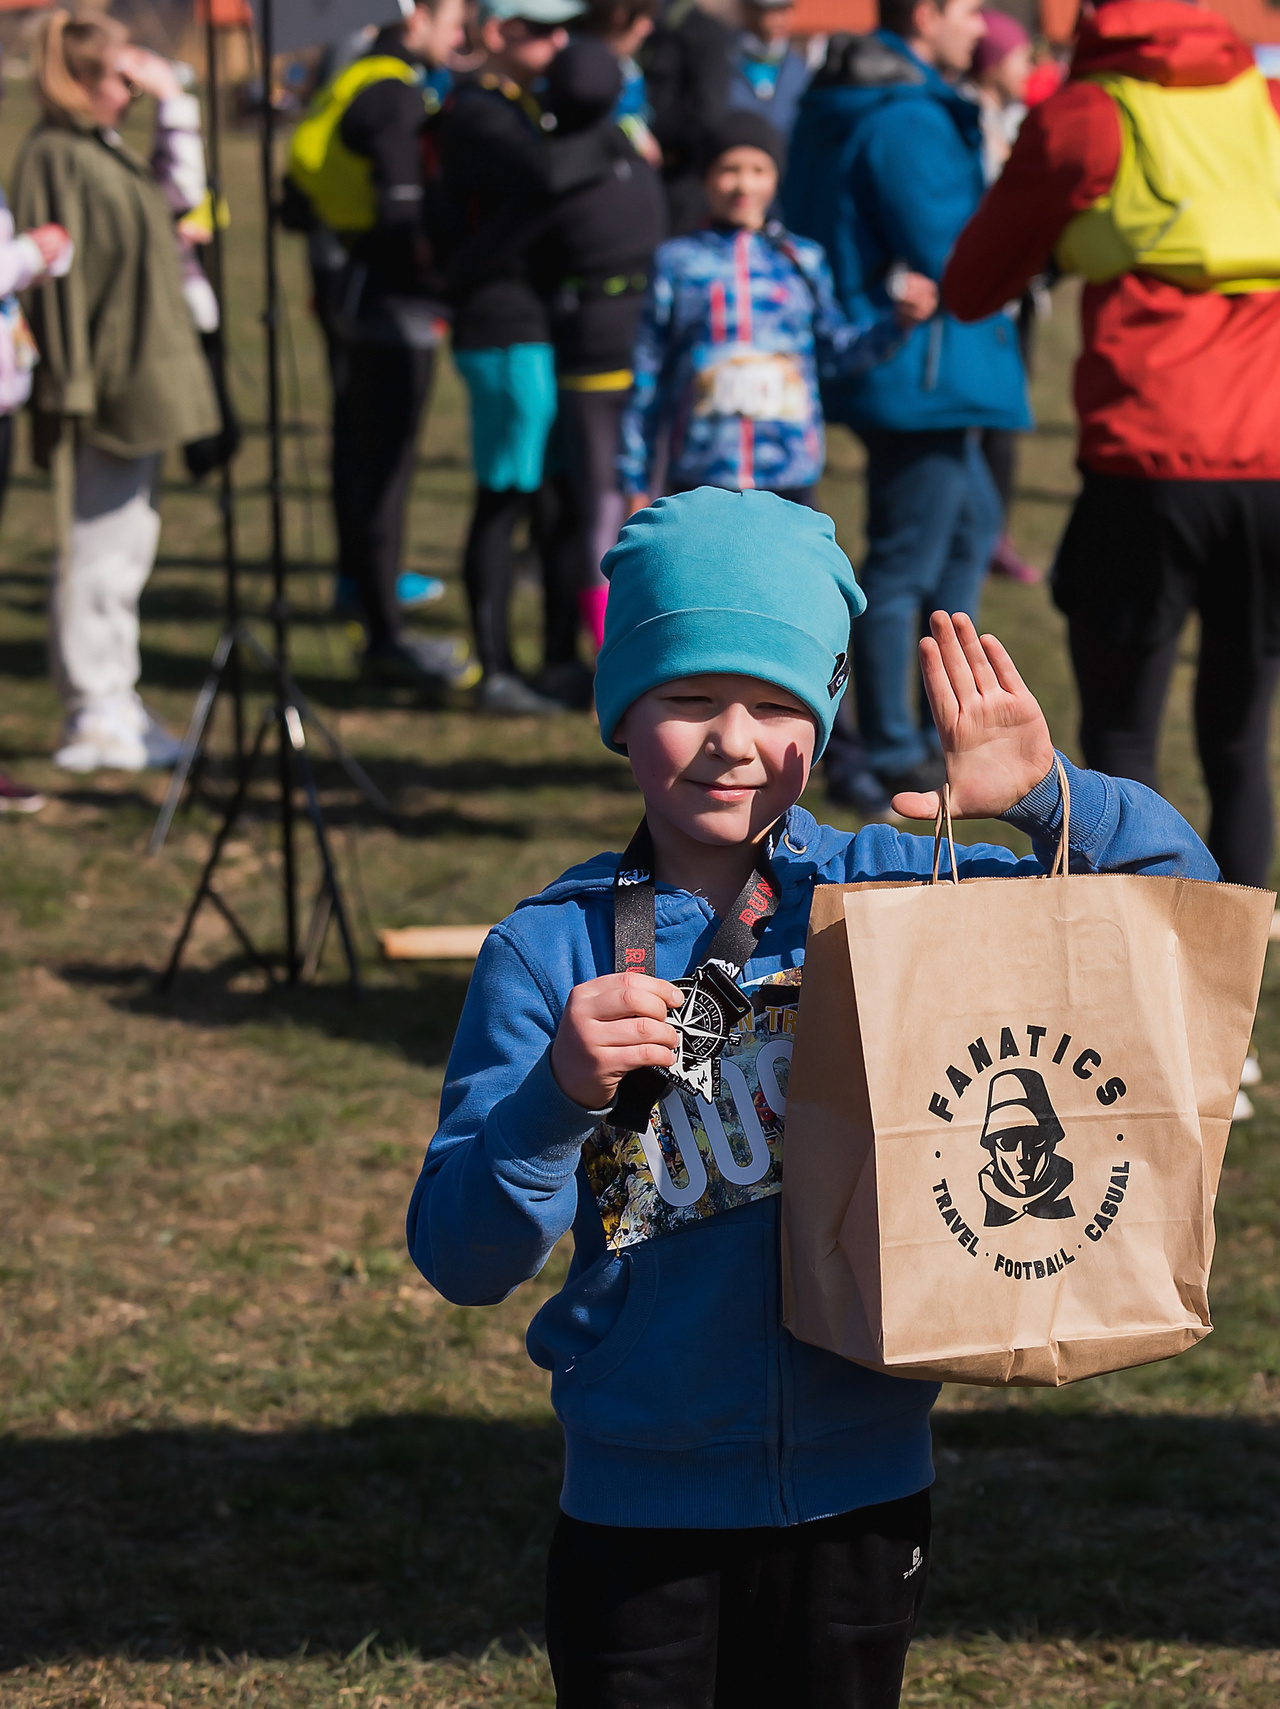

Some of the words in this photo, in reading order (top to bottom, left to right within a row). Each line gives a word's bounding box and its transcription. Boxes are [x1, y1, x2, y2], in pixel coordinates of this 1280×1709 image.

[738, 876, 773, 928] RUN
[927, 1024, 1128, 1123] FANATICS
[932, 1178, 980, 1258] TRAVEL
[993, 1247, 1076, 1281] FOOTBALL
[1084, 1161, 1131, 1242] CASUAL
